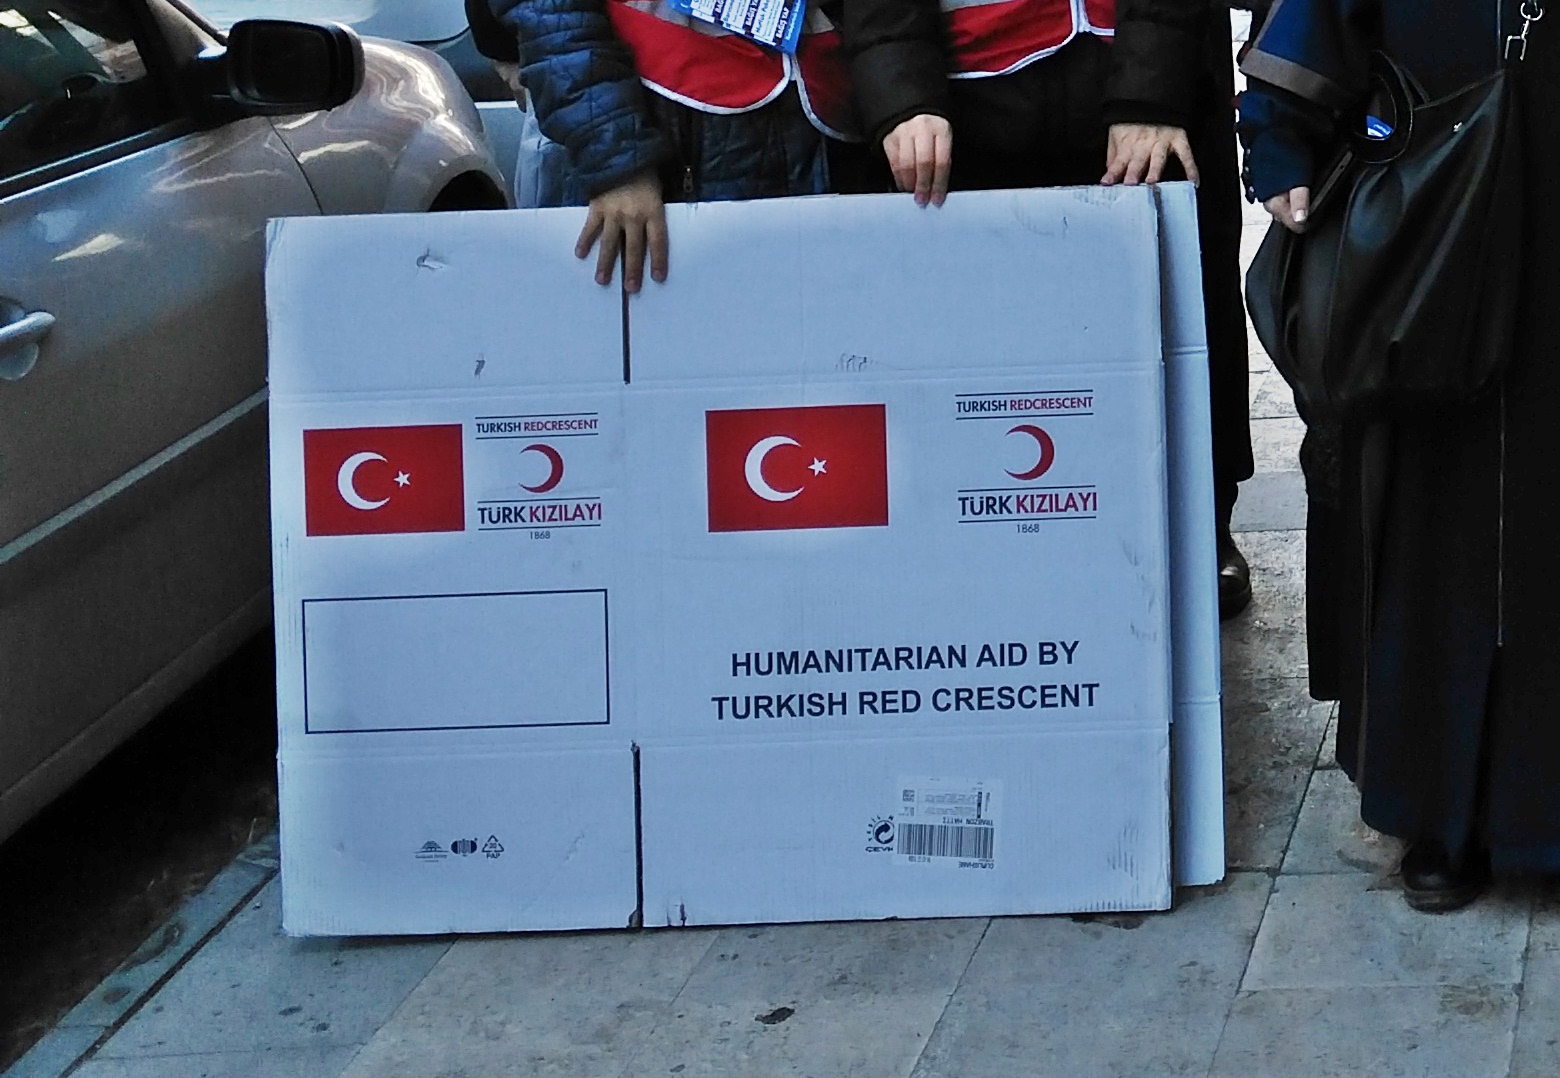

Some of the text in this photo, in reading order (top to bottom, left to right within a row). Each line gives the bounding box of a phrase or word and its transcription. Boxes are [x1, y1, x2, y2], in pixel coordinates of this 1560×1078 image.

[956, 397, 1094, 413] TURKISH REDCRESCENT
[476, 419, 599, 434] TURKISH REDCRESCENT
[477, 502, 602, 525] TÜRK KIZILAYI
[958, 492, 1098, 516] TÜRK KIZILAYI
[1016, 523, 1040, 534] 1868
[732, 640, 1080, 677] HUMANITARIAN AID BY
[711, 683, 1100, 721] TURKISH RED CRESCENT
